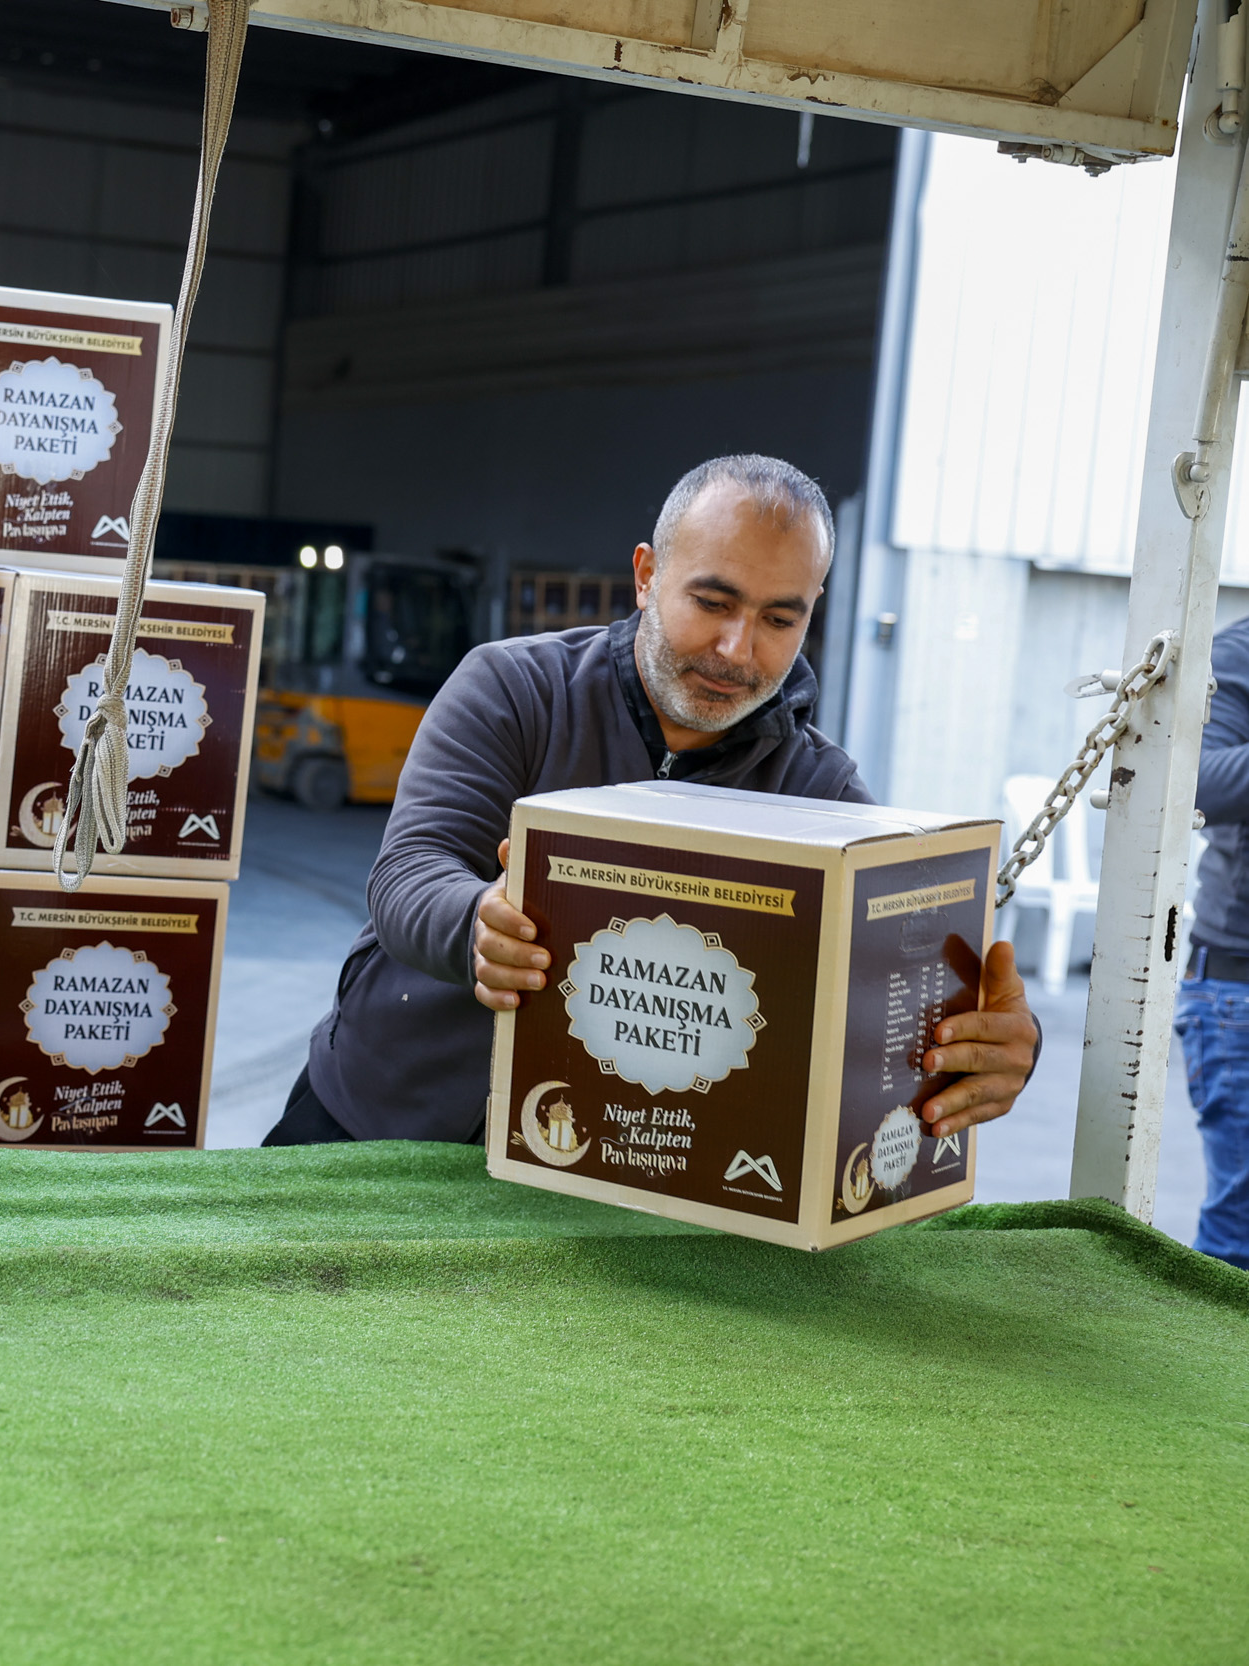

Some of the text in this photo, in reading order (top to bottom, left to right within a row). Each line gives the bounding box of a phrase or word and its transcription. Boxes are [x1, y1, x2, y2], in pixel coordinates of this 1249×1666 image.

[26, 329, 84, 345] BÜYÜKŞEHİR
[86, 336, 135, 350] BELEDİYESİ
[3, 387, 96, 412] RAMAZAN
[14, 434, 78, 455] PAKETİ
[5, 493, 38, 511] Niyet
[23, 507, 71, 525] Kalpten
[73, 617, 110, 629] MERSİN
[176, 627, 227, 639] BELEDİYESİ
[557, 863, 784, 909] T.C. MERSİN BÜYÜKŞEHİR BELEDİYESİ
[20, 911, 191, 928] T.C. MERSİN BÜYÜKŞEHİR BELEDİYESİ
[53, 975, 149, 995] RAMAZAN
[599, 953, 728, 996] RAMAZAN
[44, 999, 153, 1023] DAYANIŞMA
[588, 983, 733, 1031] DAYANIŞMA
[64, 1020, 131, 1041] PAKETİ
[614, 1020, 702, 1057] PAKETİ
[54, 1080, 126, 1104] Niyet Ettik,
[74, 1098, 122, 1116] Kalpten
[603, 1103, 696, 1131] Niyet Ettik,
[629, 1125, 693, 1151] Kalpten
[881, 1124, 913, 1143] RAMAZAN
